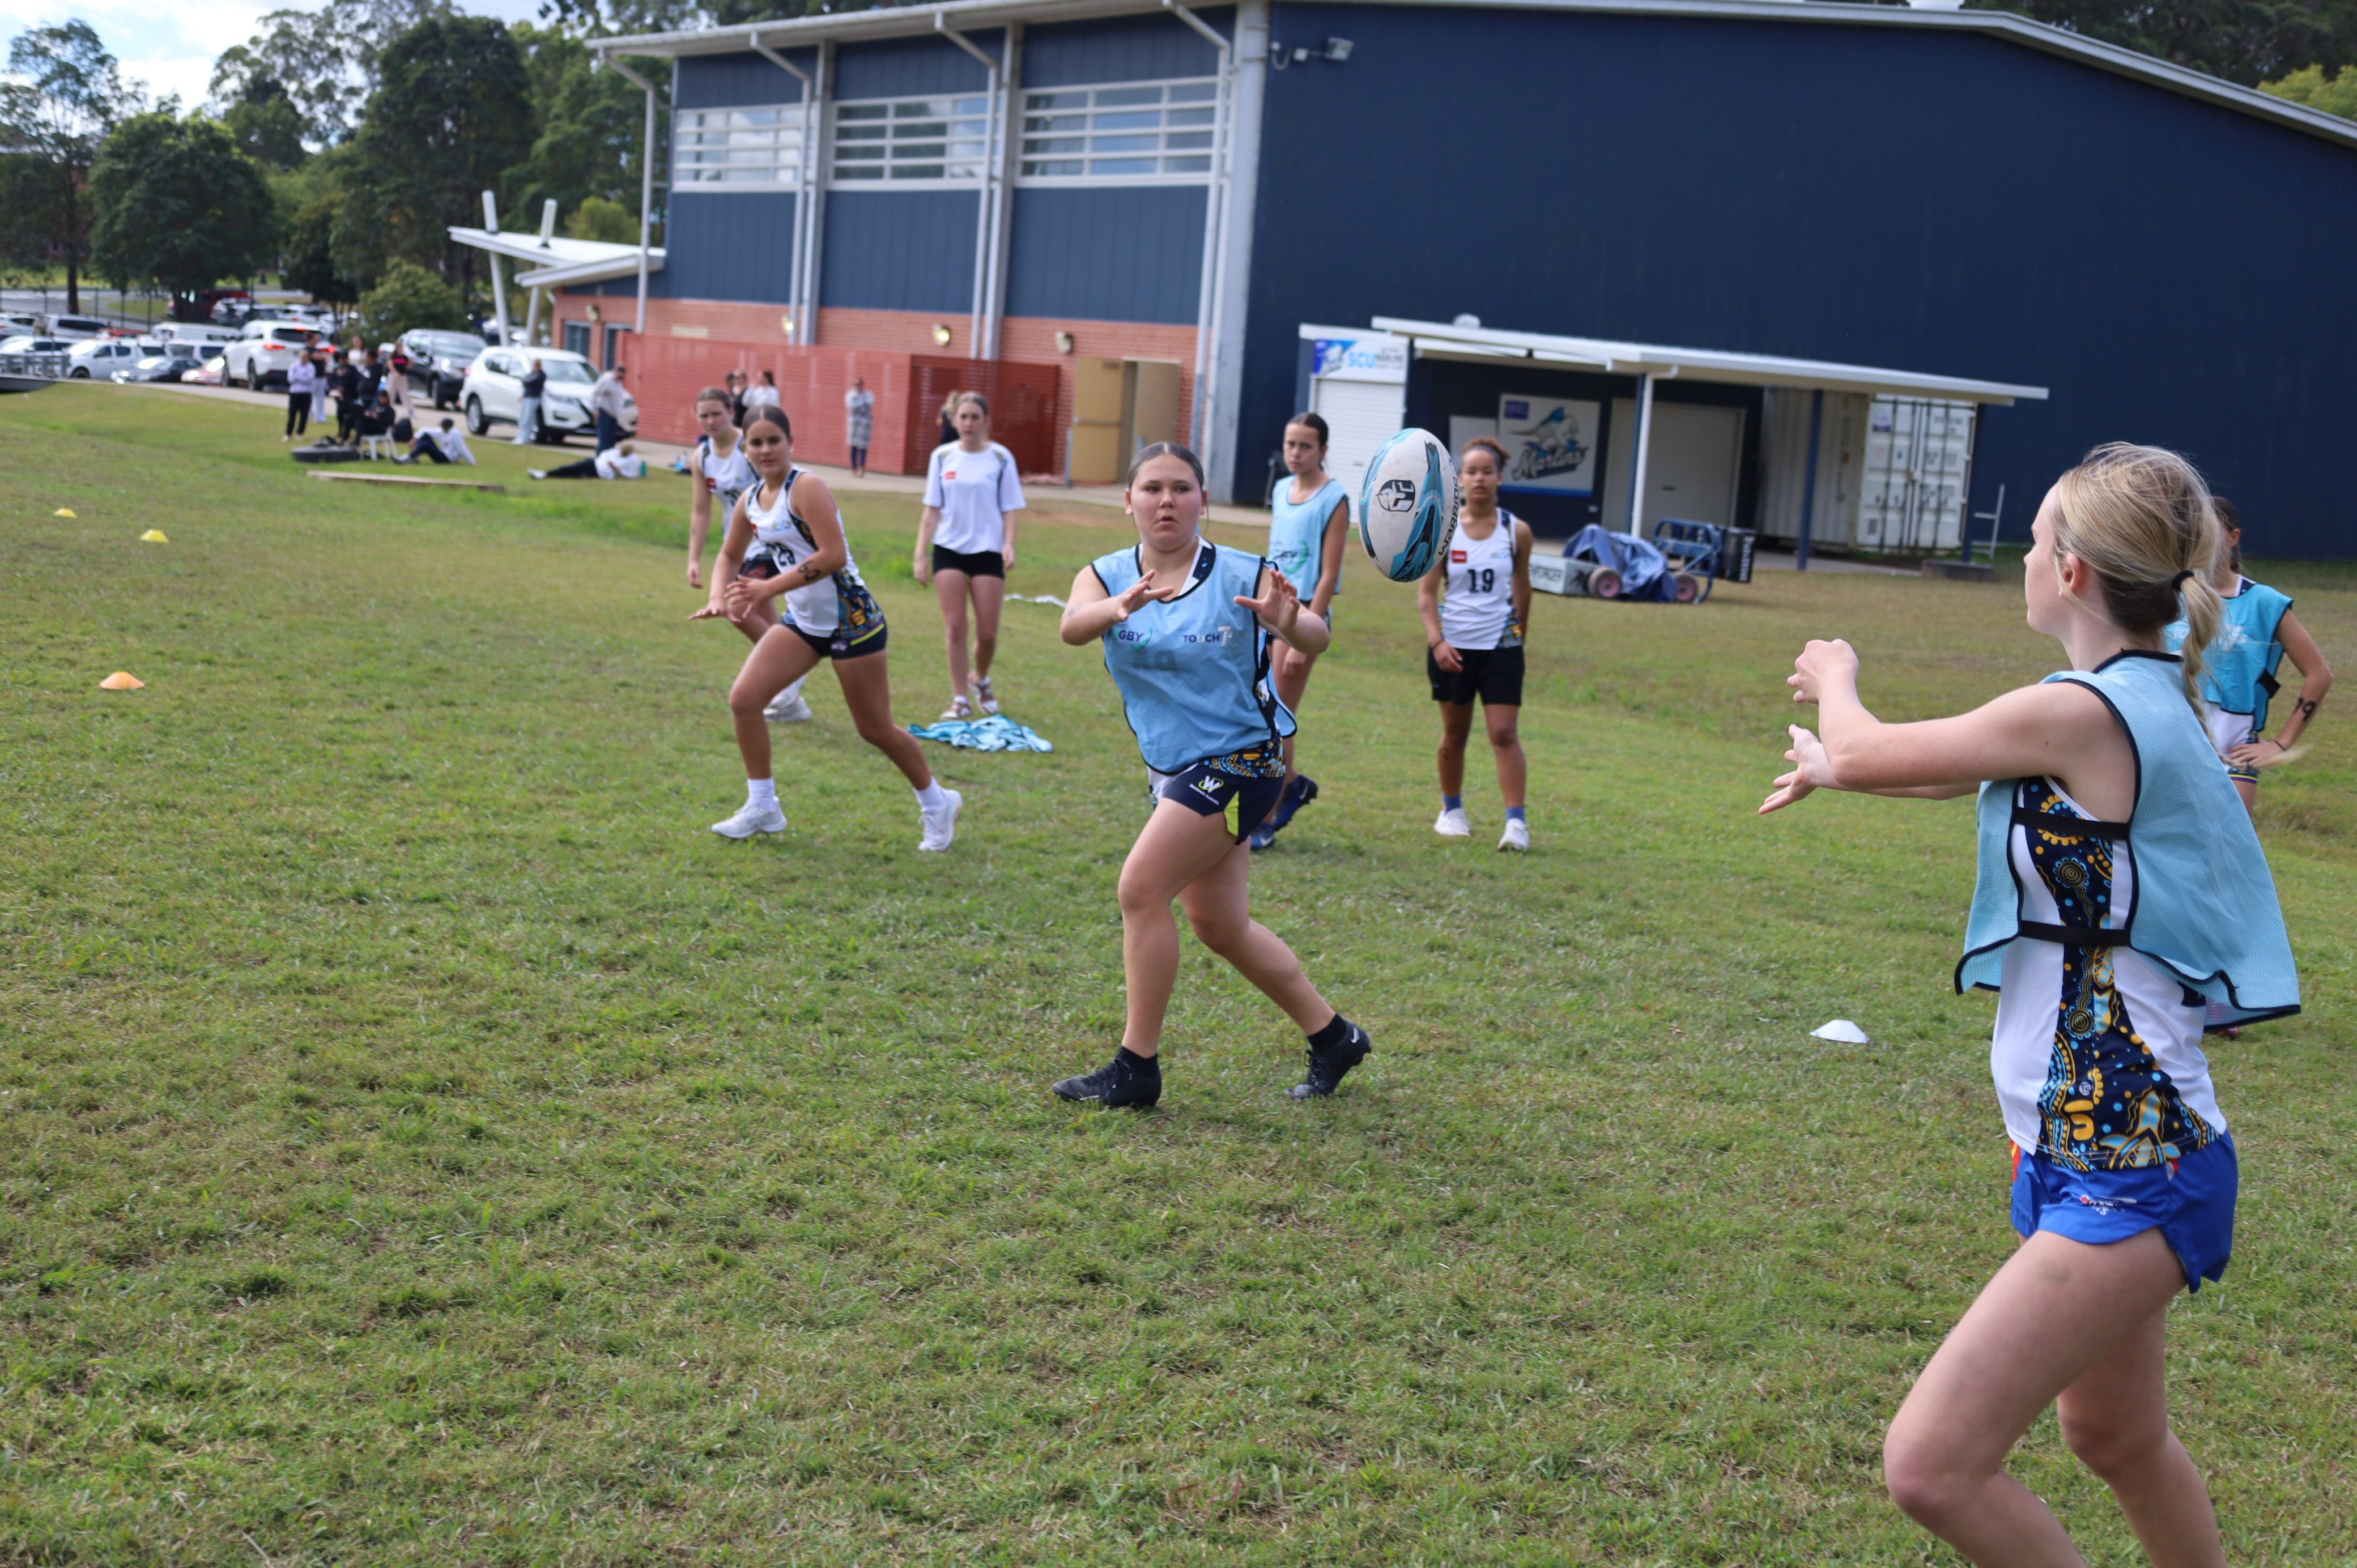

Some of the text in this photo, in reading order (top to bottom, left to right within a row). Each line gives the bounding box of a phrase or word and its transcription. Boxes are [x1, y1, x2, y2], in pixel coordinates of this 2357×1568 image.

[1348, 351, 1377, 368] SCU
[1511, 445, 1588, 481] Marlins
[1466, 568, 1495, 594] 19
[2294, 697, 2316, 722] 19
